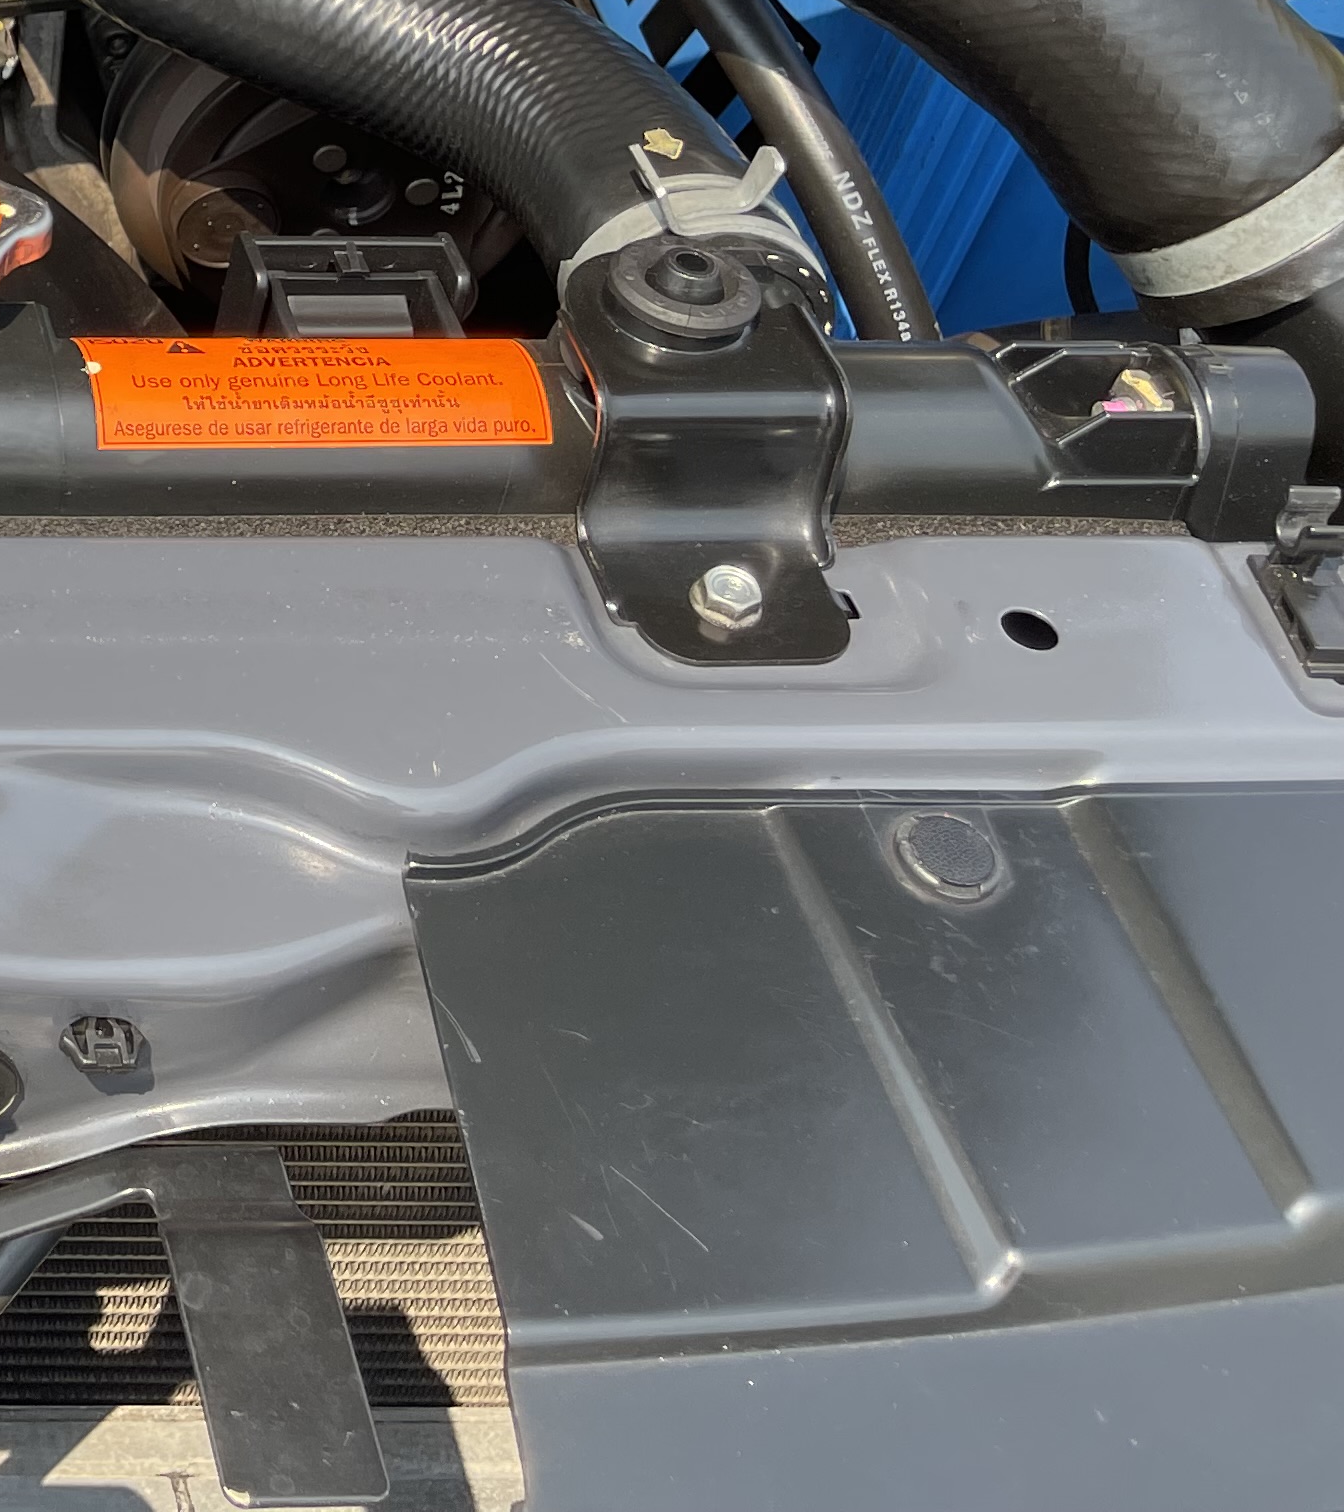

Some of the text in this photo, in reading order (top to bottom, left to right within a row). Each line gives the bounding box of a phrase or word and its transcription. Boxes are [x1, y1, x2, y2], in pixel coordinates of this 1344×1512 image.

[834, 171, 873, 230] NDZ
[863, 237, 892, 285] FLEX
[233, 356, 391, 368] ADVERTENCIA
[131, 372, 504, 391] Use only genuine Long Life Coolant.
[113, 417, 536, 440] Asegurese de usar refrigerante de larga vida puro.
